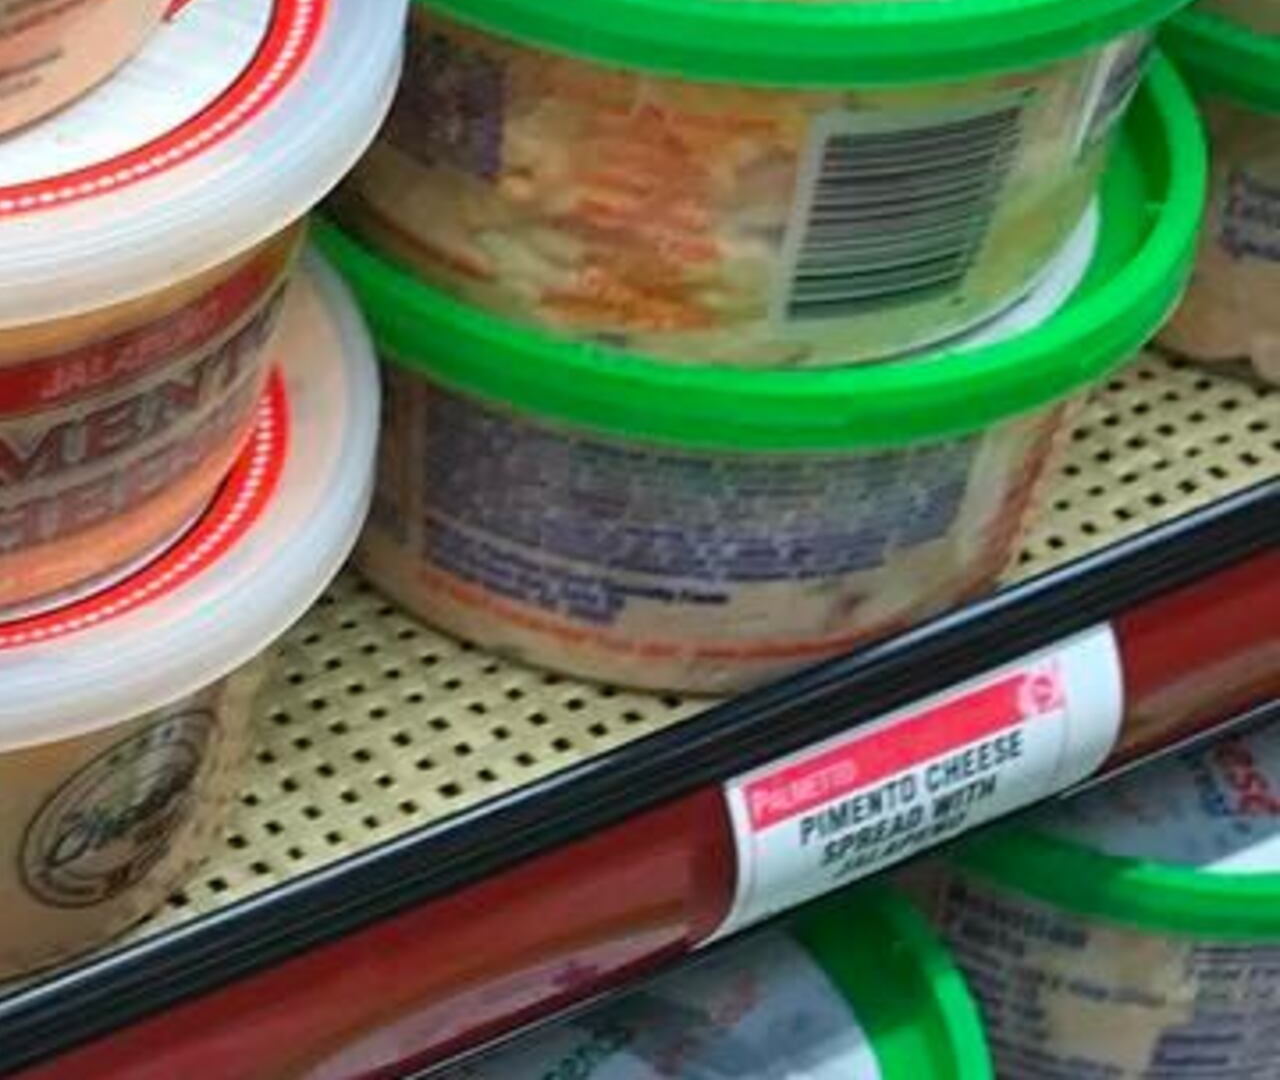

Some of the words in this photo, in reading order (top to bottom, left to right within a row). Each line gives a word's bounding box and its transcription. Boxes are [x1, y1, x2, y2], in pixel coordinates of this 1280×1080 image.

[798, 774, 918, 845] PIMENTO
[925, 728, 1024, 796] CHEESE
[820, 803, 926, 866] SPREAD
[931, 775, 998, 818] WITH
